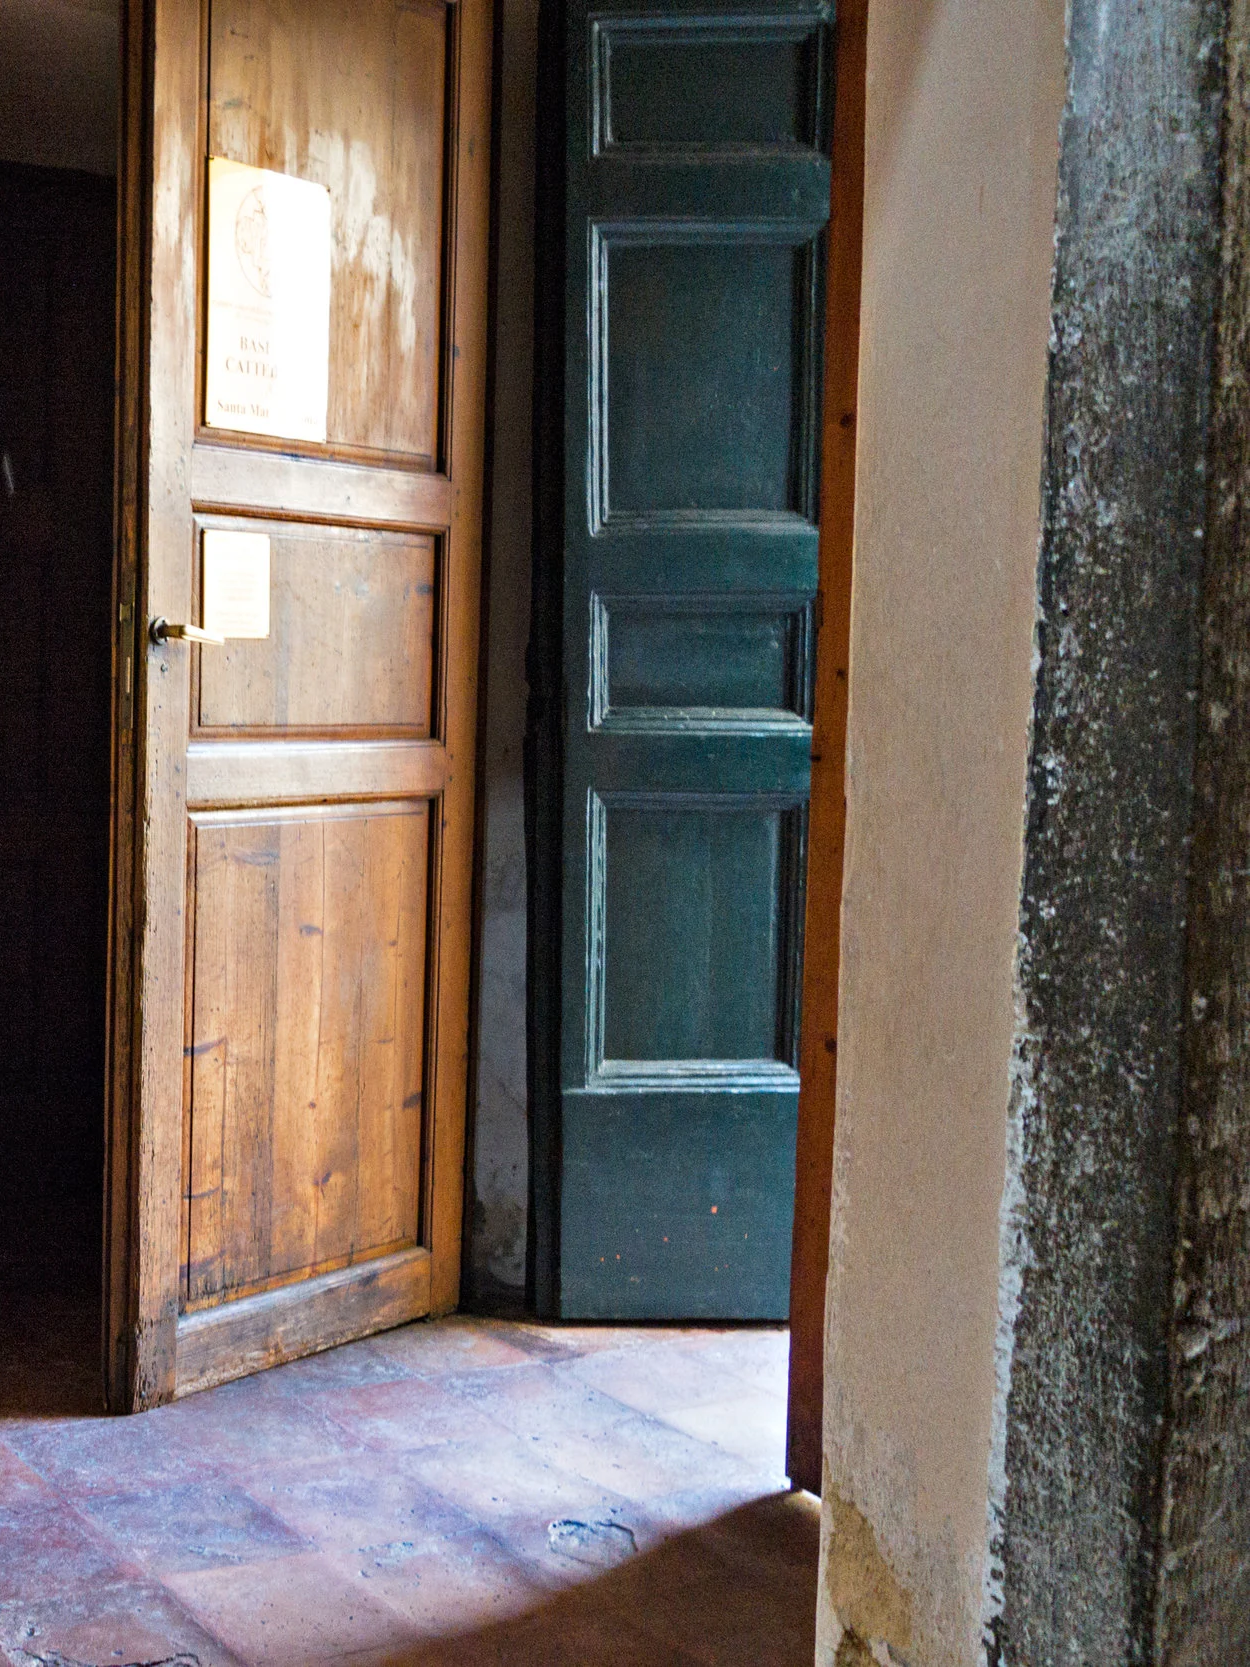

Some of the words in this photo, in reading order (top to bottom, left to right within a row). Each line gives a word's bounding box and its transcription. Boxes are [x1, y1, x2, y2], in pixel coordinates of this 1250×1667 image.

[239, 335, 271, 356] BASI
[216, 398, 246, 416] Santa
[250, 402, 270, 419] Mar
